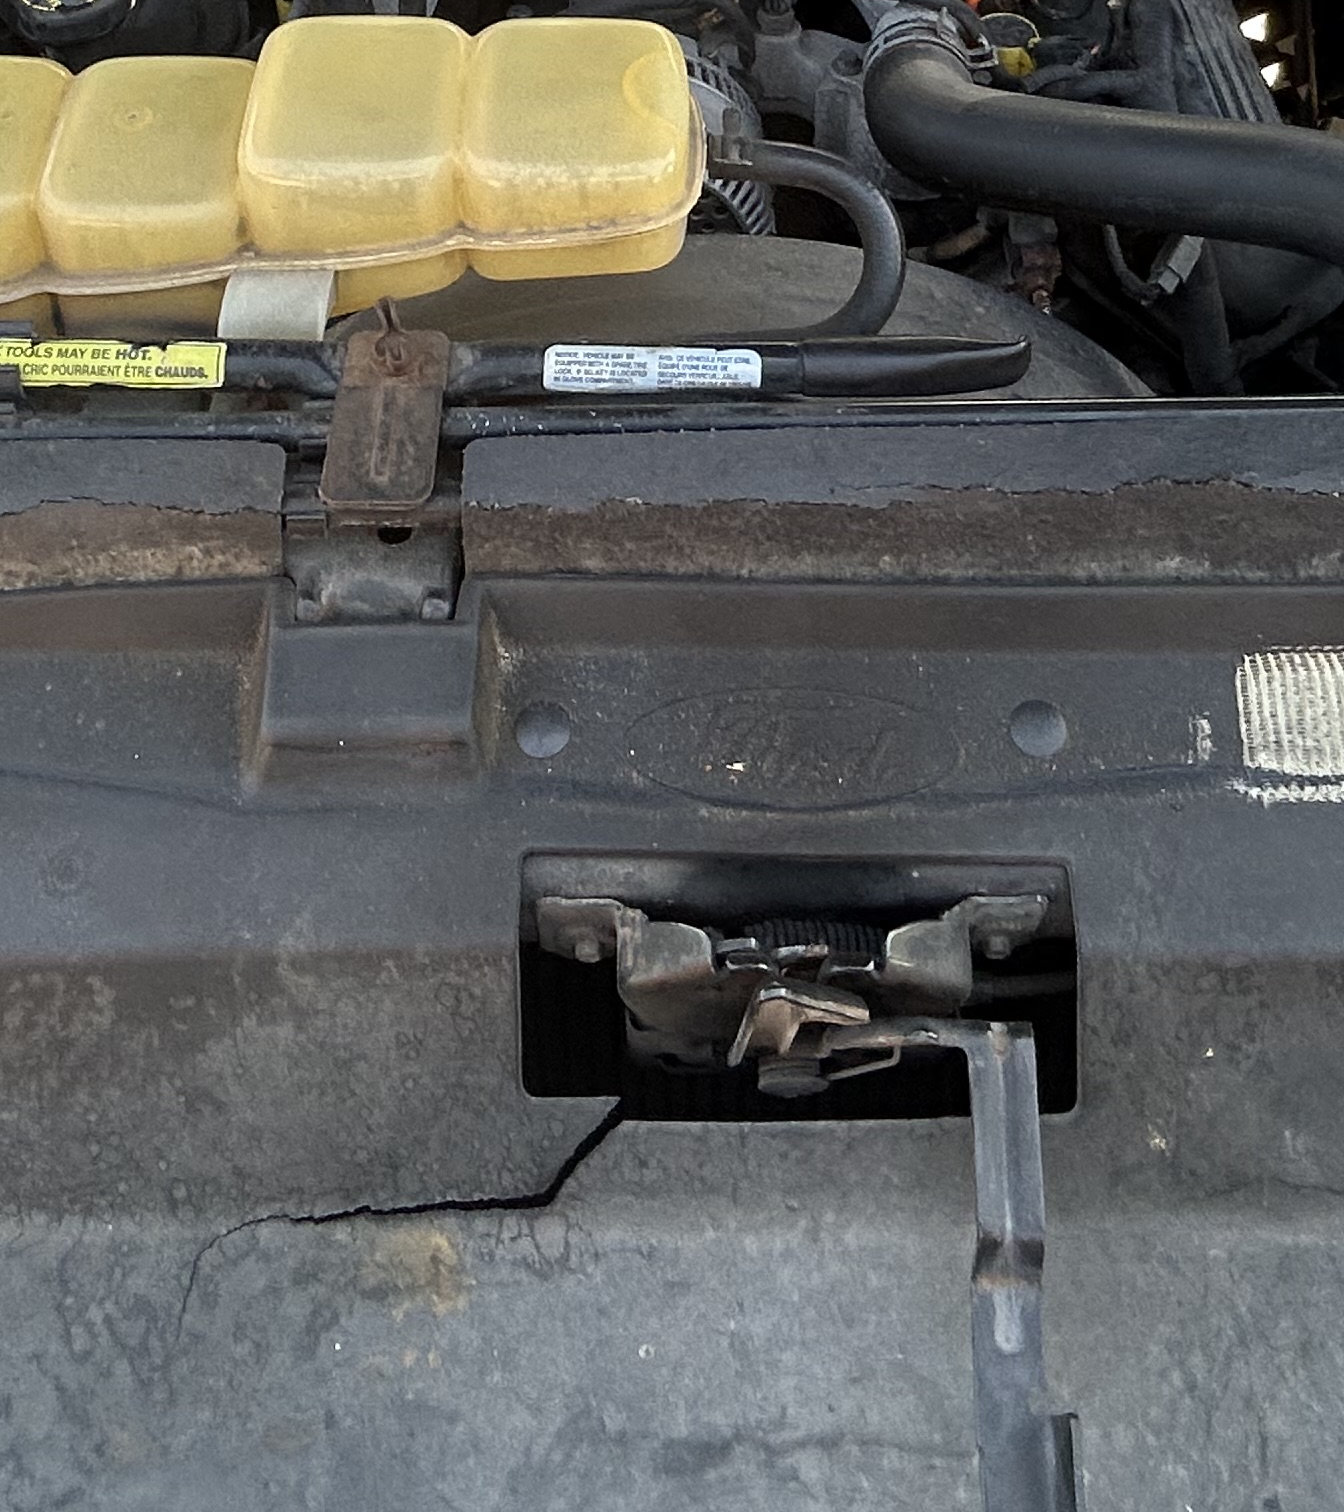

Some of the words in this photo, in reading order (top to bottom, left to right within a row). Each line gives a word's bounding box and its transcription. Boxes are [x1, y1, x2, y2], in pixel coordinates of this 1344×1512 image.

[6, 346, 53, 358] TOOLS
[56, 347, 88, 359] MAY
[90, 348, 111, 360] BE
[22, 363, 48, 375] CRIC
[51, 363, 122, 377] POURRAIENT
